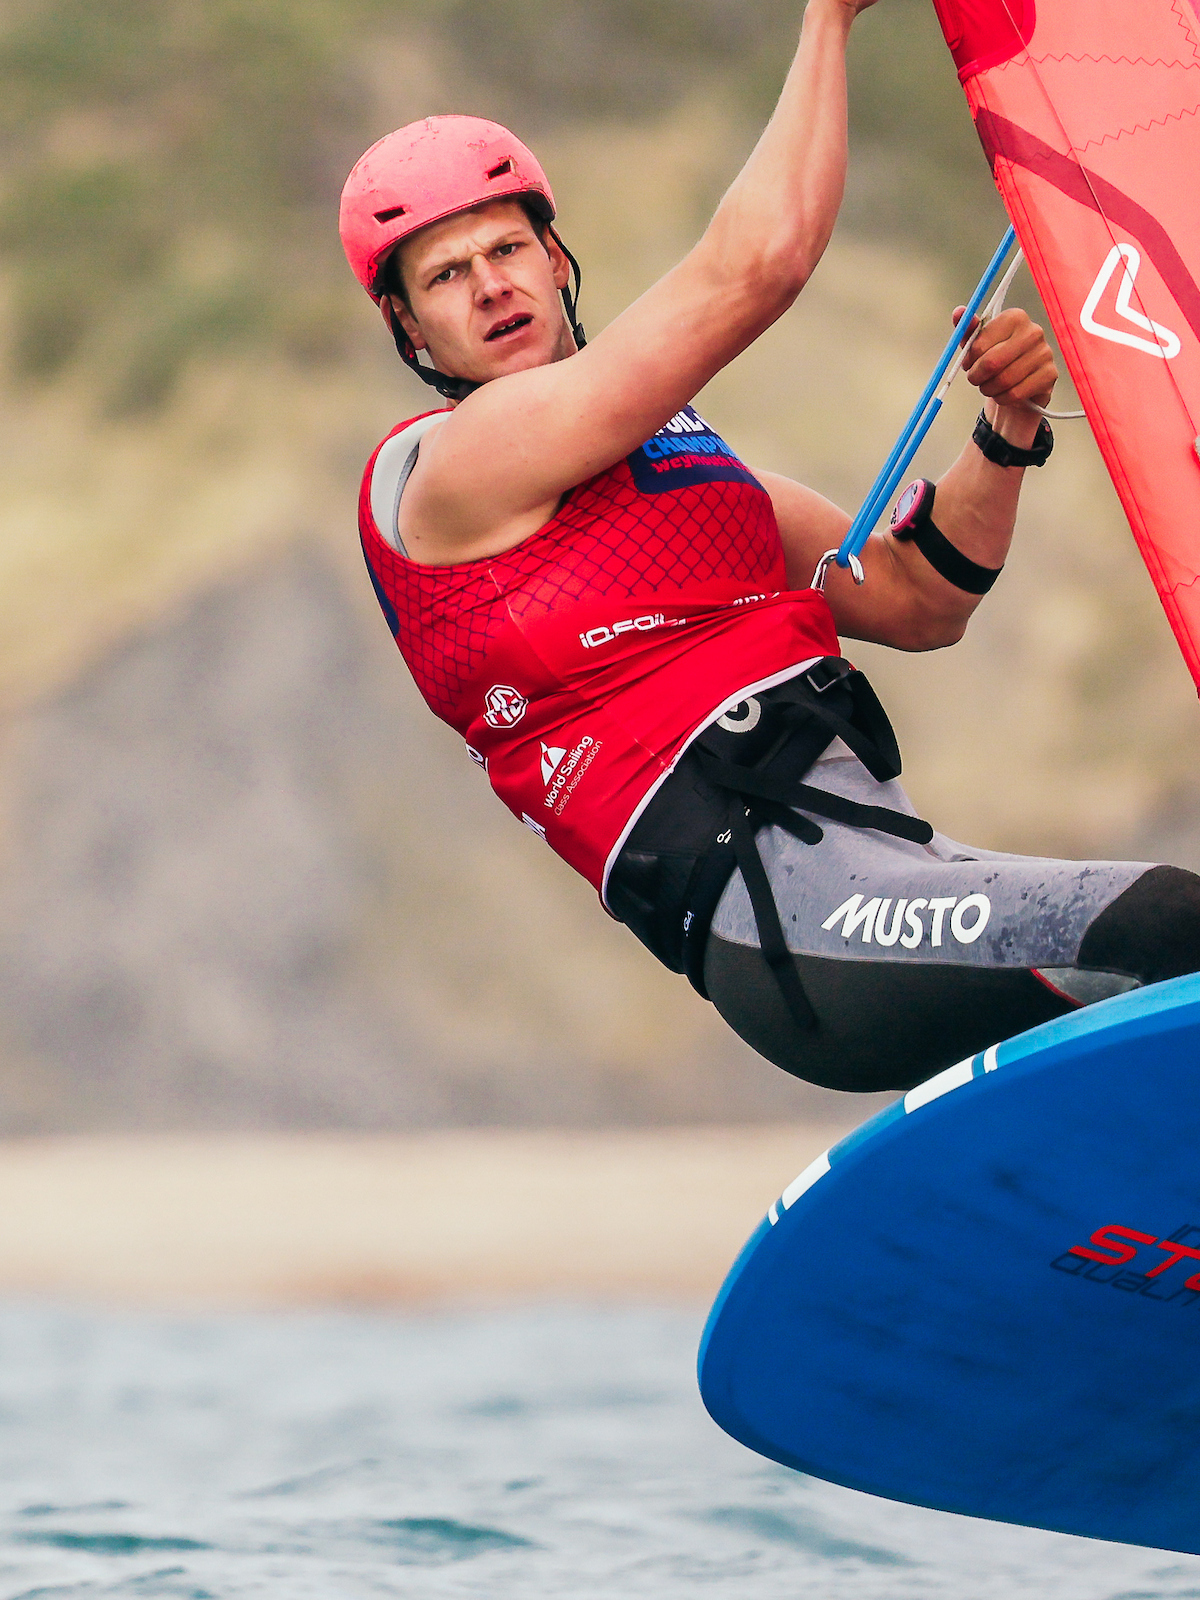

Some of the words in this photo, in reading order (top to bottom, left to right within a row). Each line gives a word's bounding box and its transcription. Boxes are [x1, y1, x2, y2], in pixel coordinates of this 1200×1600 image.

[543, 774, 567, 809] World
[561, 735, 594, 777] Sailing
[554, 793, 570, 816] Class
[566, 740, 603, 794] Association
[820, 893, 992, 949] MUSTO
